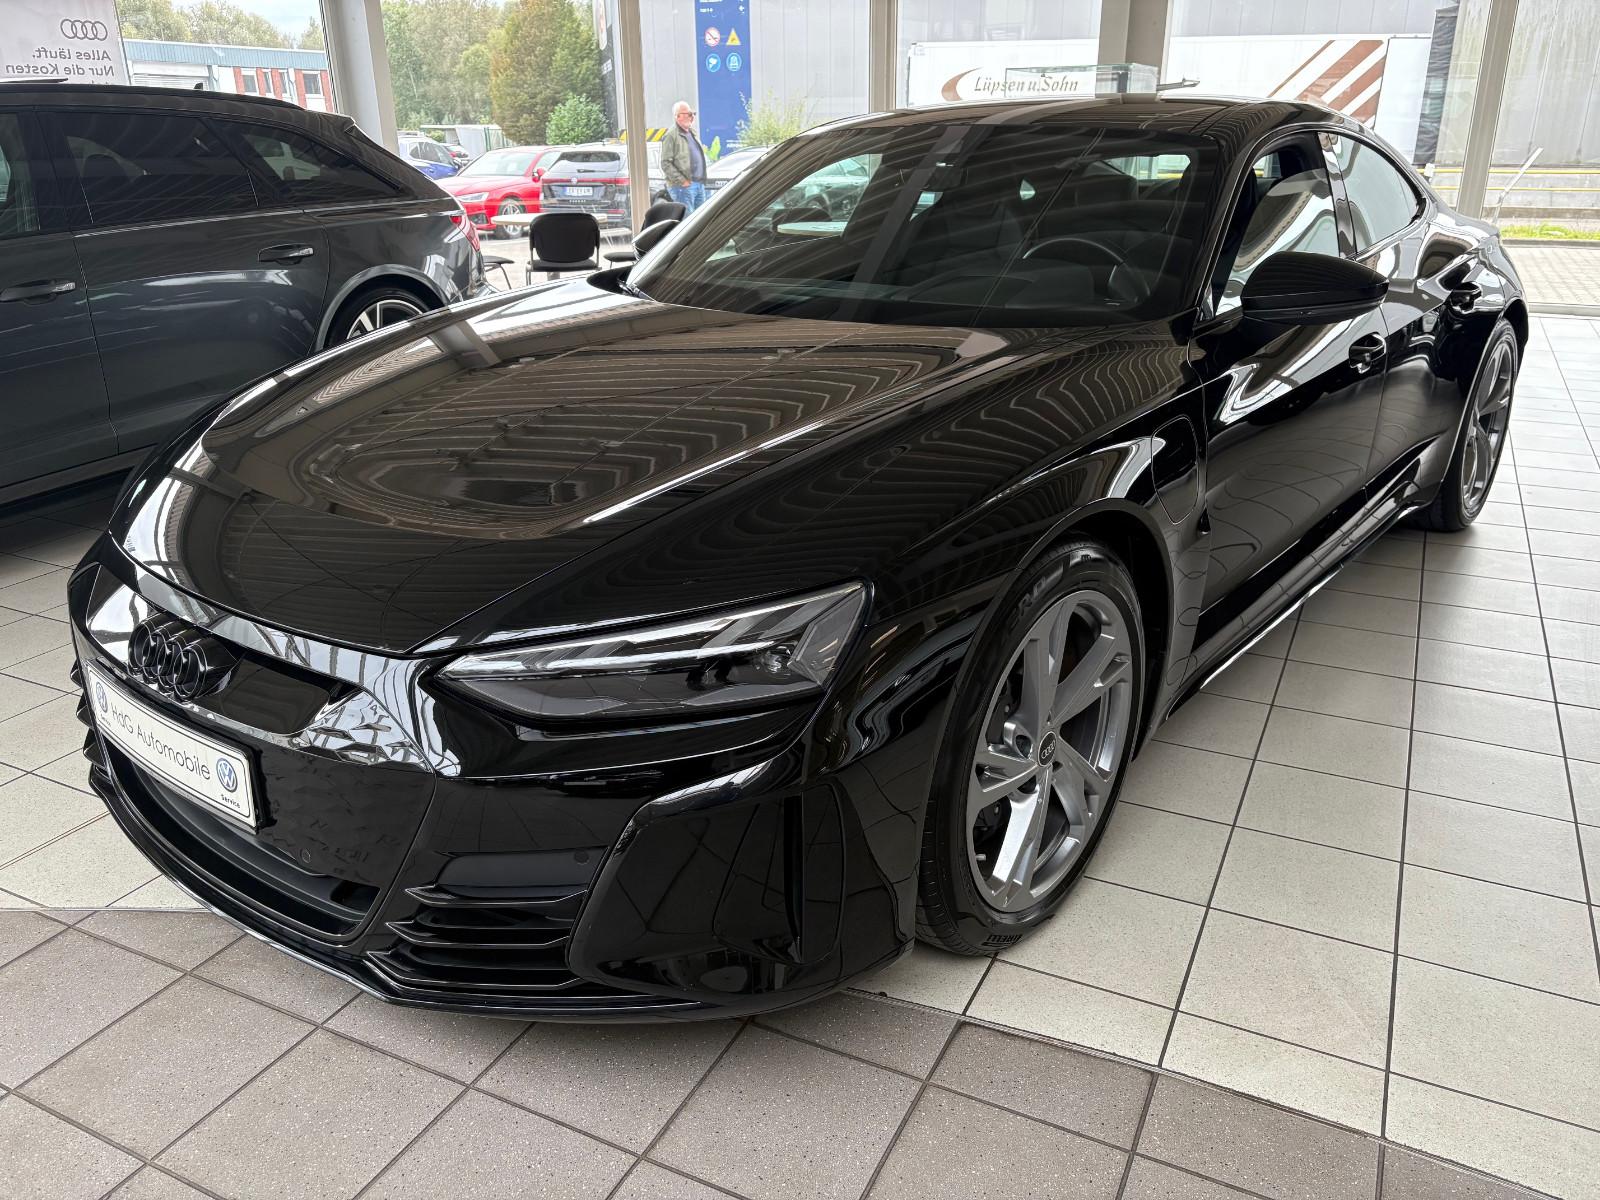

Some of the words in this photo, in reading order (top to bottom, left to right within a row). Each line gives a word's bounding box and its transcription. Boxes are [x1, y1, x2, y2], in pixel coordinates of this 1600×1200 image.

[974, 76, 1025, 95] Lüpsen
[110, 702, 134, 734] HdG
[137, 723, 211, 780] Automobile
